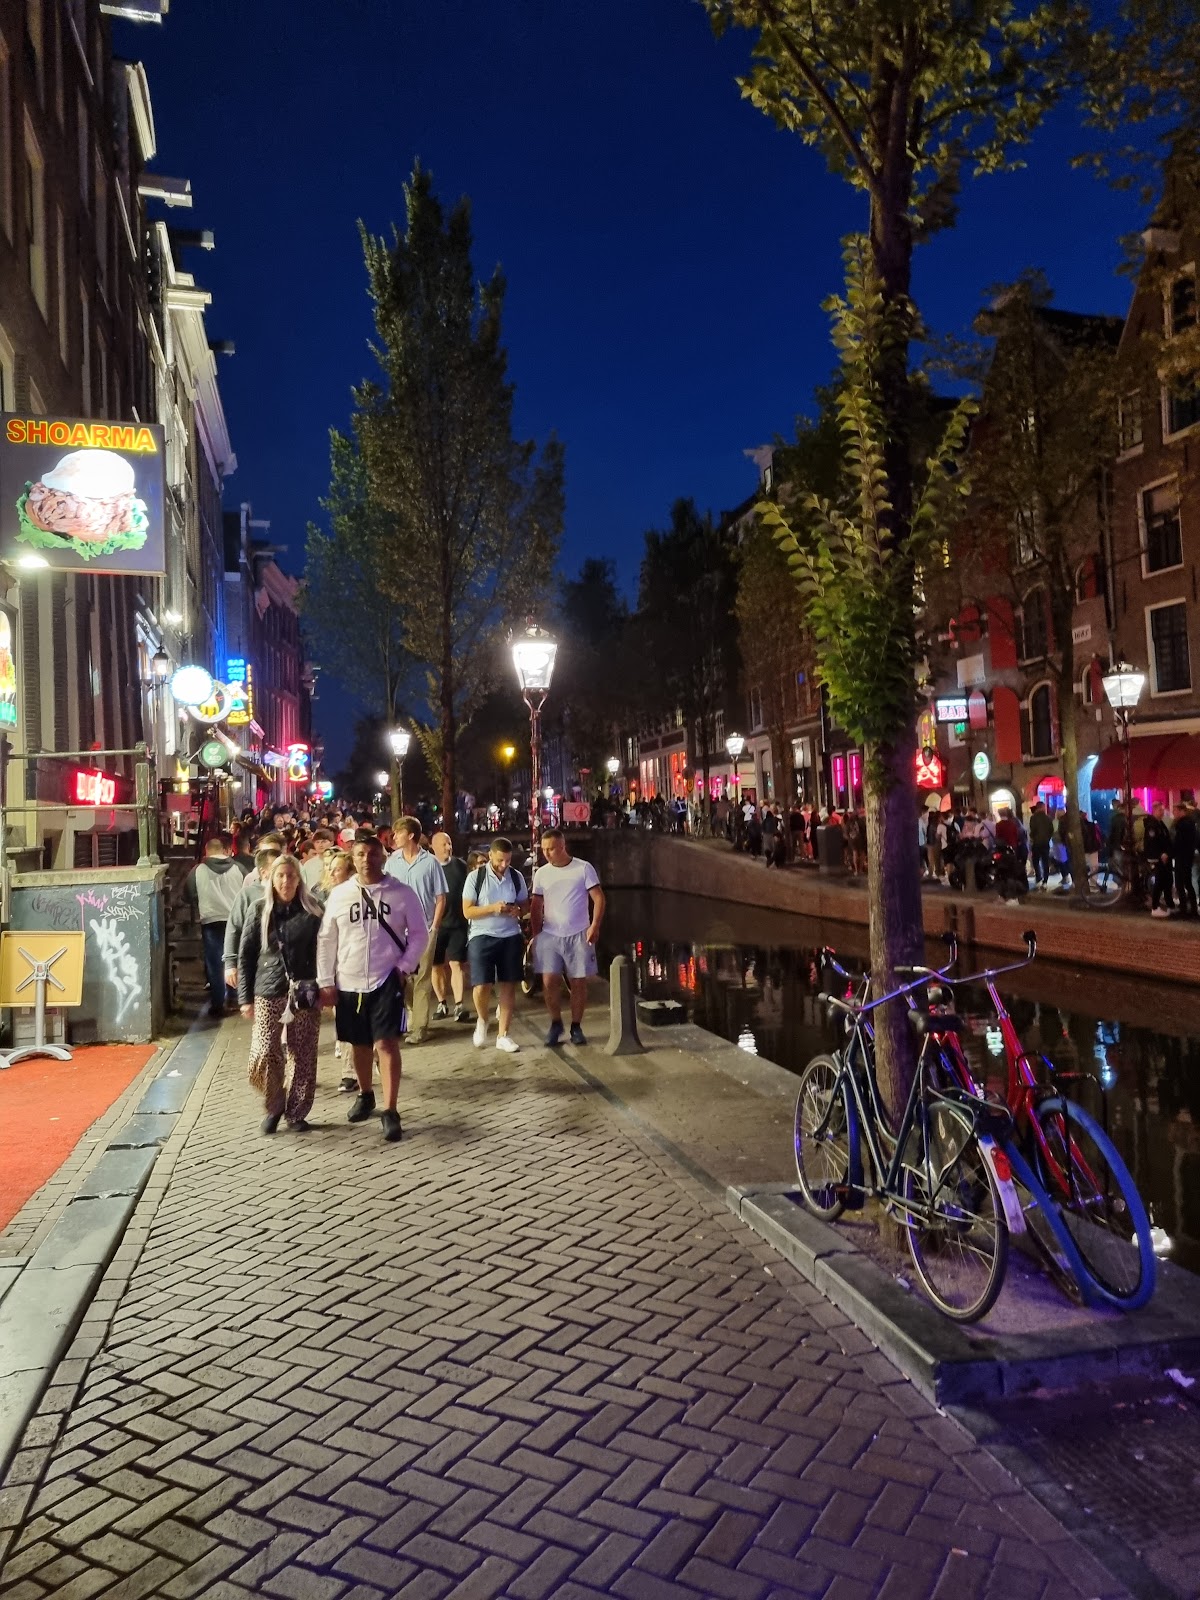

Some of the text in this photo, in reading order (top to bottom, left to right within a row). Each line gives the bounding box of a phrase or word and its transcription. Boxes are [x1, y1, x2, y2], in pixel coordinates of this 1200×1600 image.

[6, 419, 158, 452] SHOARMA
[938, 706, 967, 720] BAR
[349, 899, 392, 923] GAP
